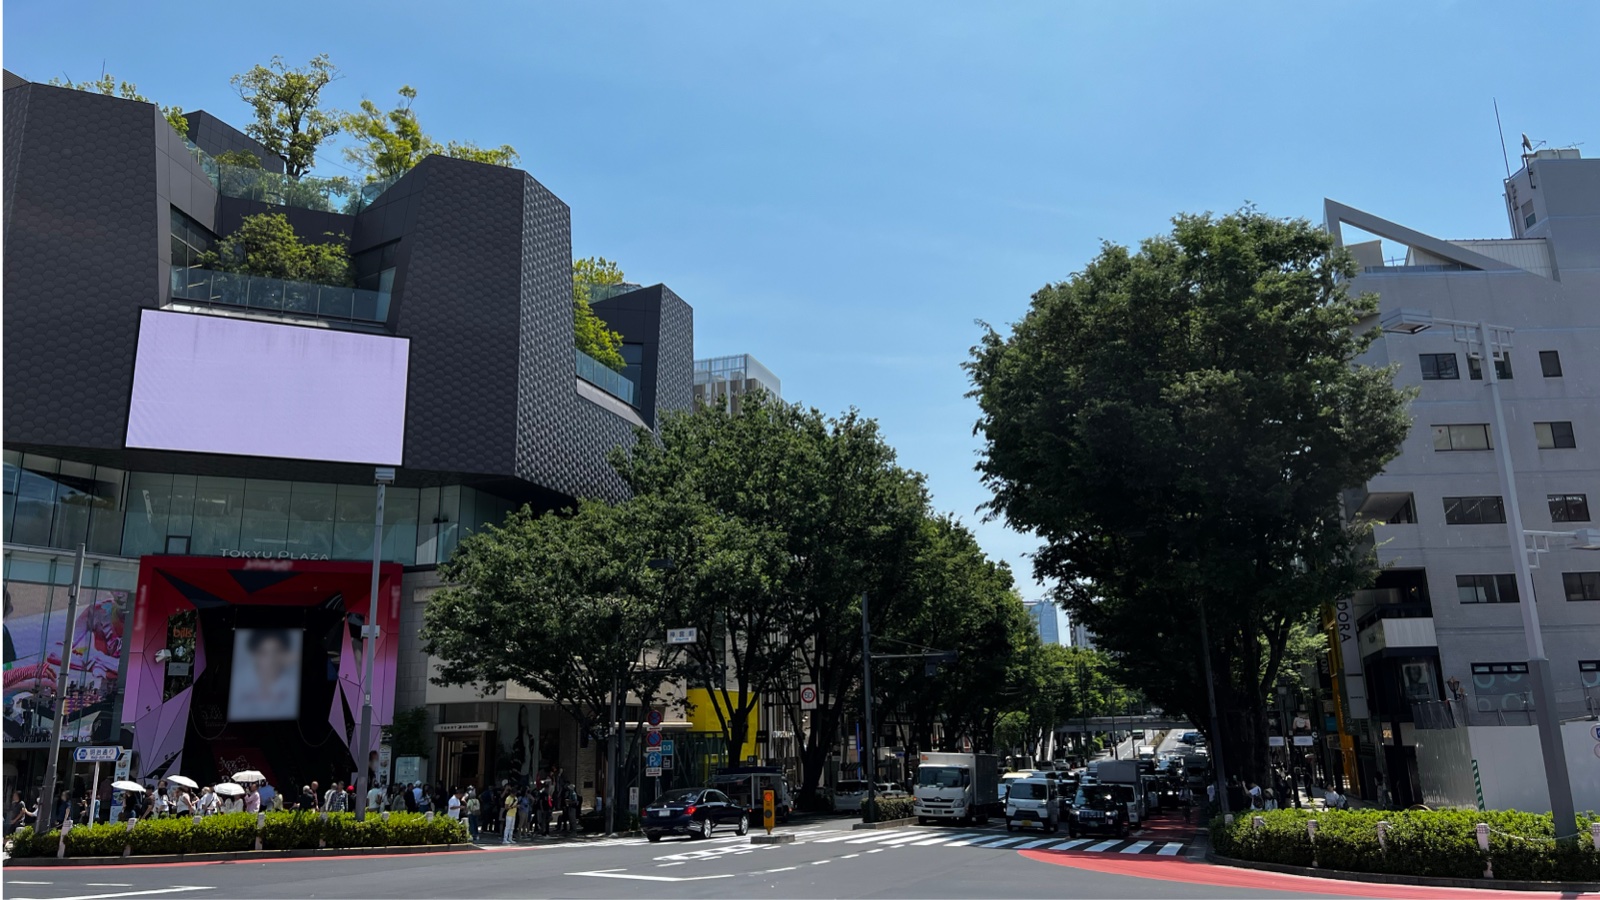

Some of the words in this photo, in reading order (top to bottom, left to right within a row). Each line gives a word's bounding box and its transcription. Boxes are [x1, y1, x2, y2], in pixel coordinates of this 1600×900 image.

[220, 549, 273, 559] TOKYU
[278, 550, 329, 561] PLAZA
[173, 626, 193, 638] bills
